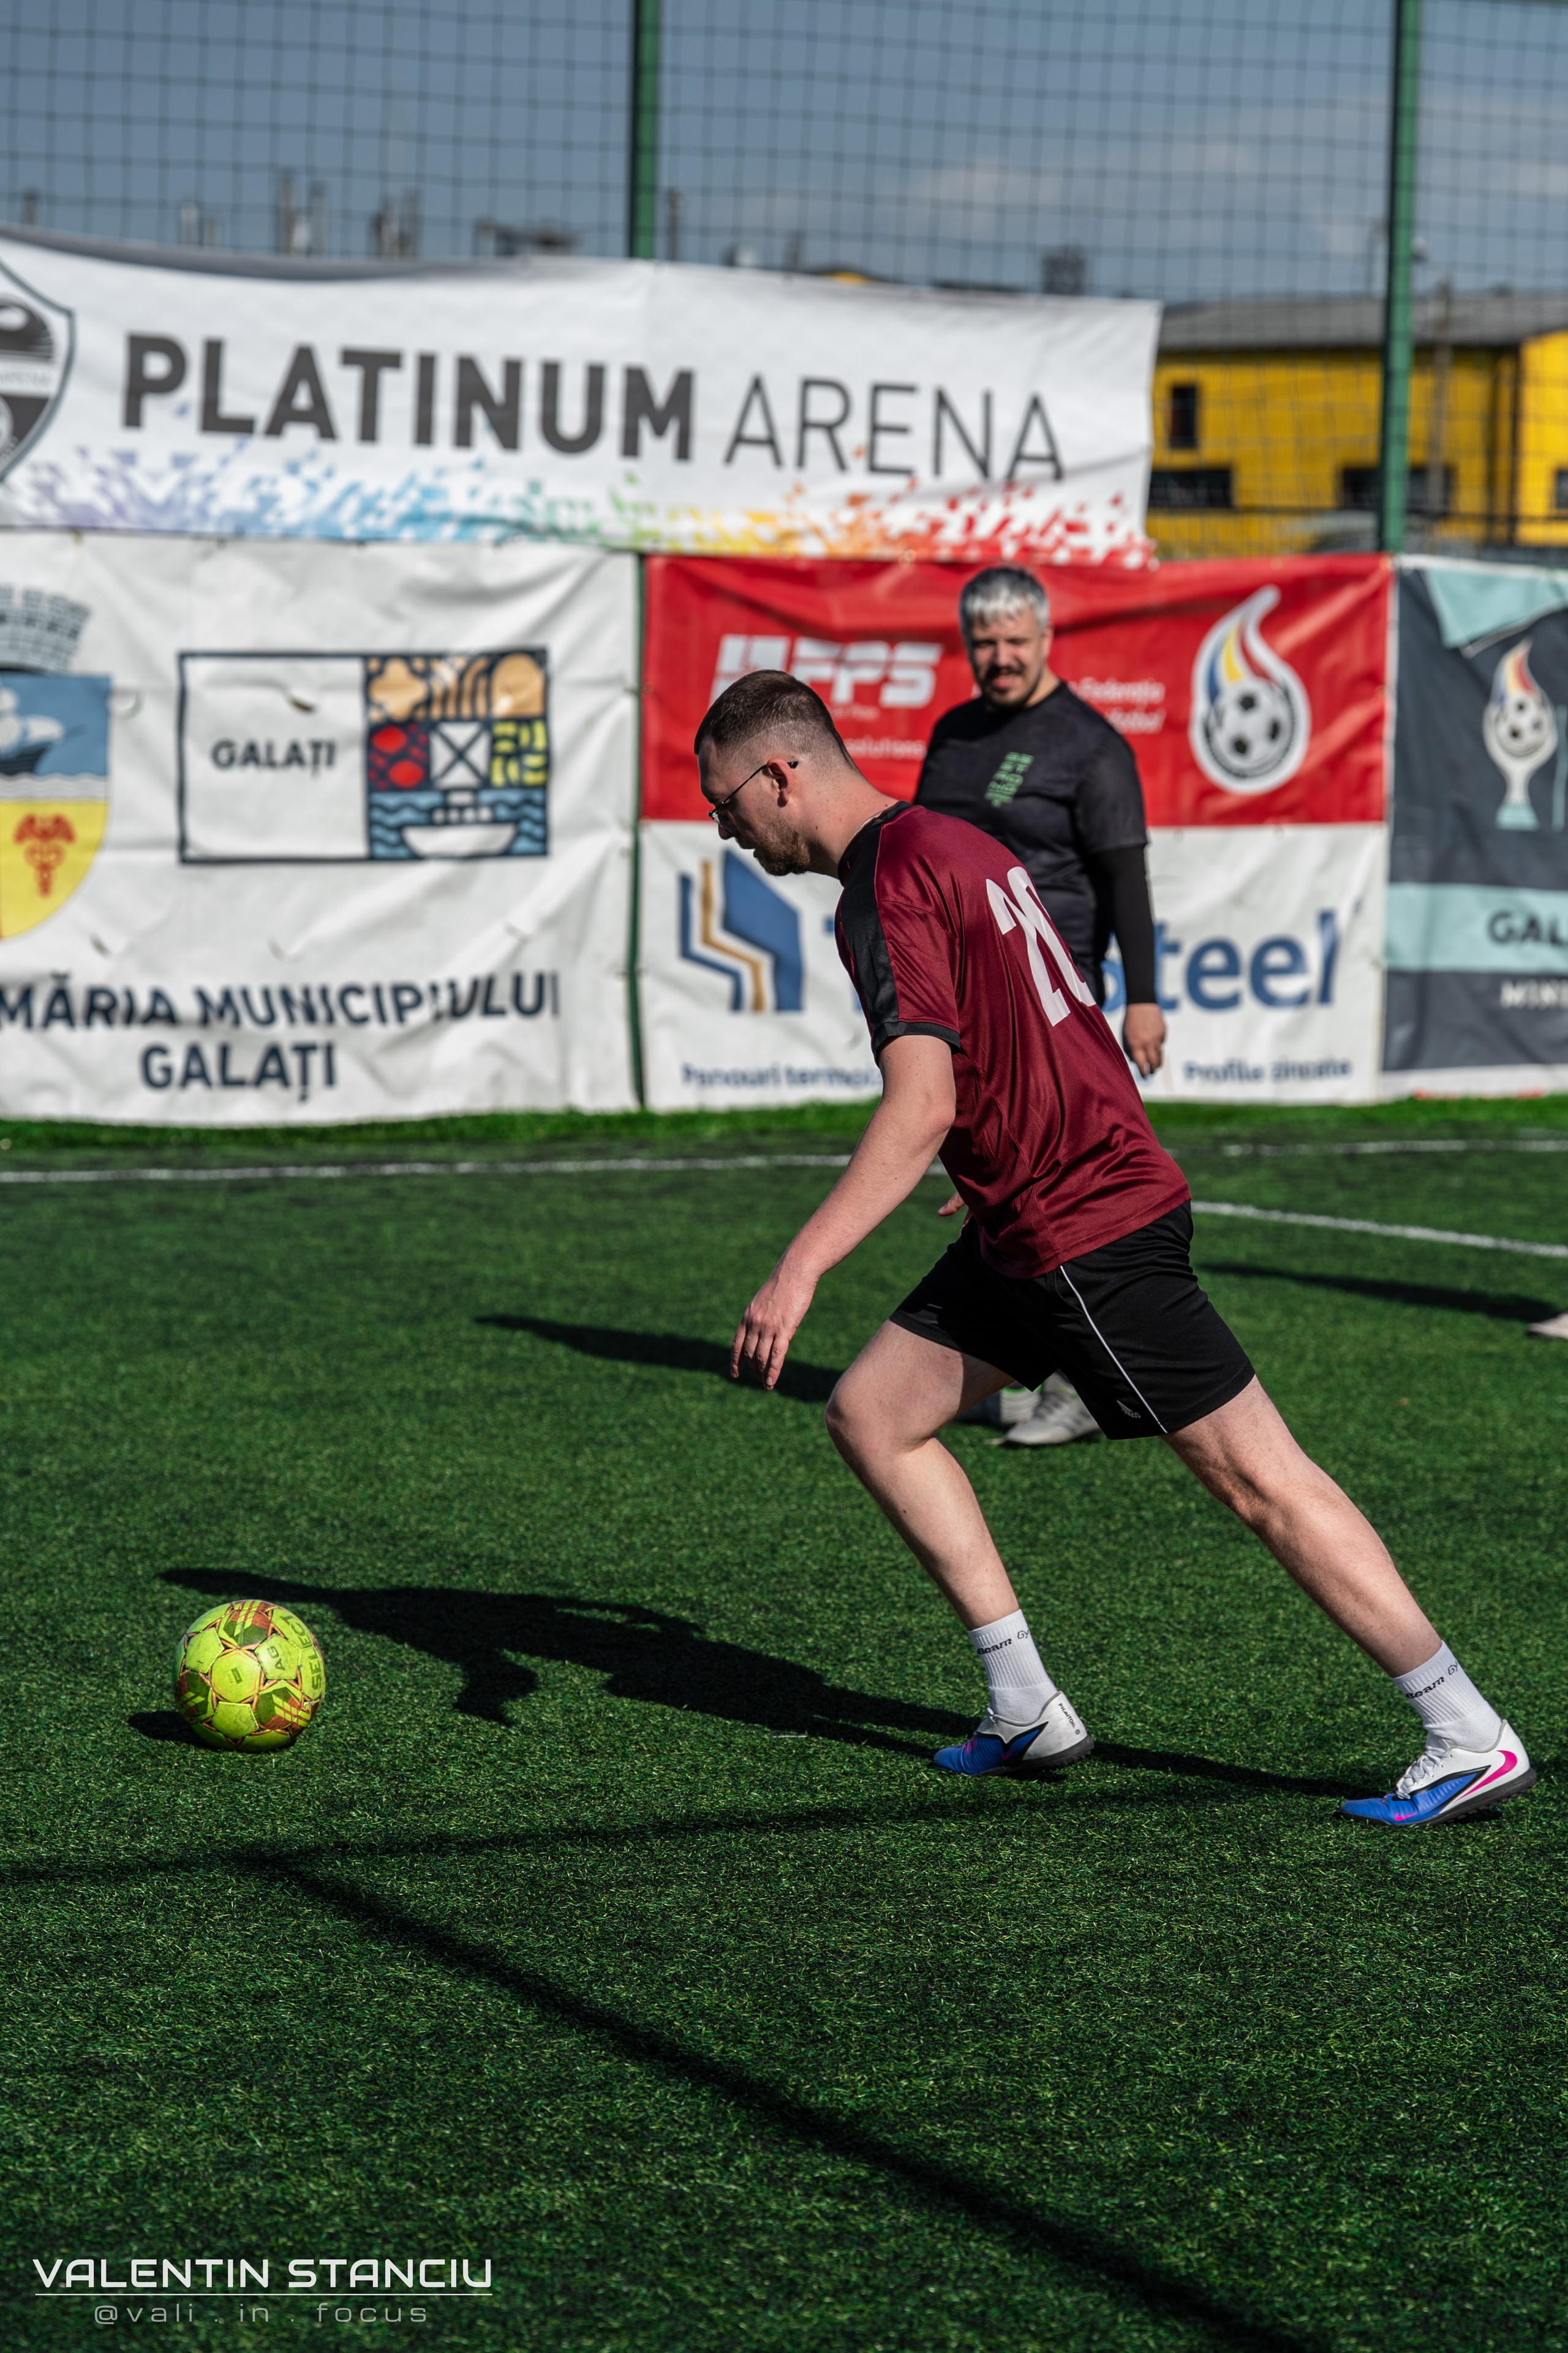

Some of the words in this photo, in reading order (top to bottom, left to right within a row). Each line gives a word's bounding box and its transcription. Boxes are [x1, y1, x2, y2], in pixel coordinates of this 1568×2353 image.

[122, 331, 696, 463] PLATINUM
[723, 372, 1064, 482] ARENA
[211, 739, 336, 778] GALAȚI
[194, 969, 560, 1030] MUNICIPIULUI
[140, 1040, 337, 1101] GALAȚI
[280, 1615, 321, 1690] SELECT
[977, 1638, 1012, 1655] Beam
[1406, 1676, 1445, 1699] Beam
